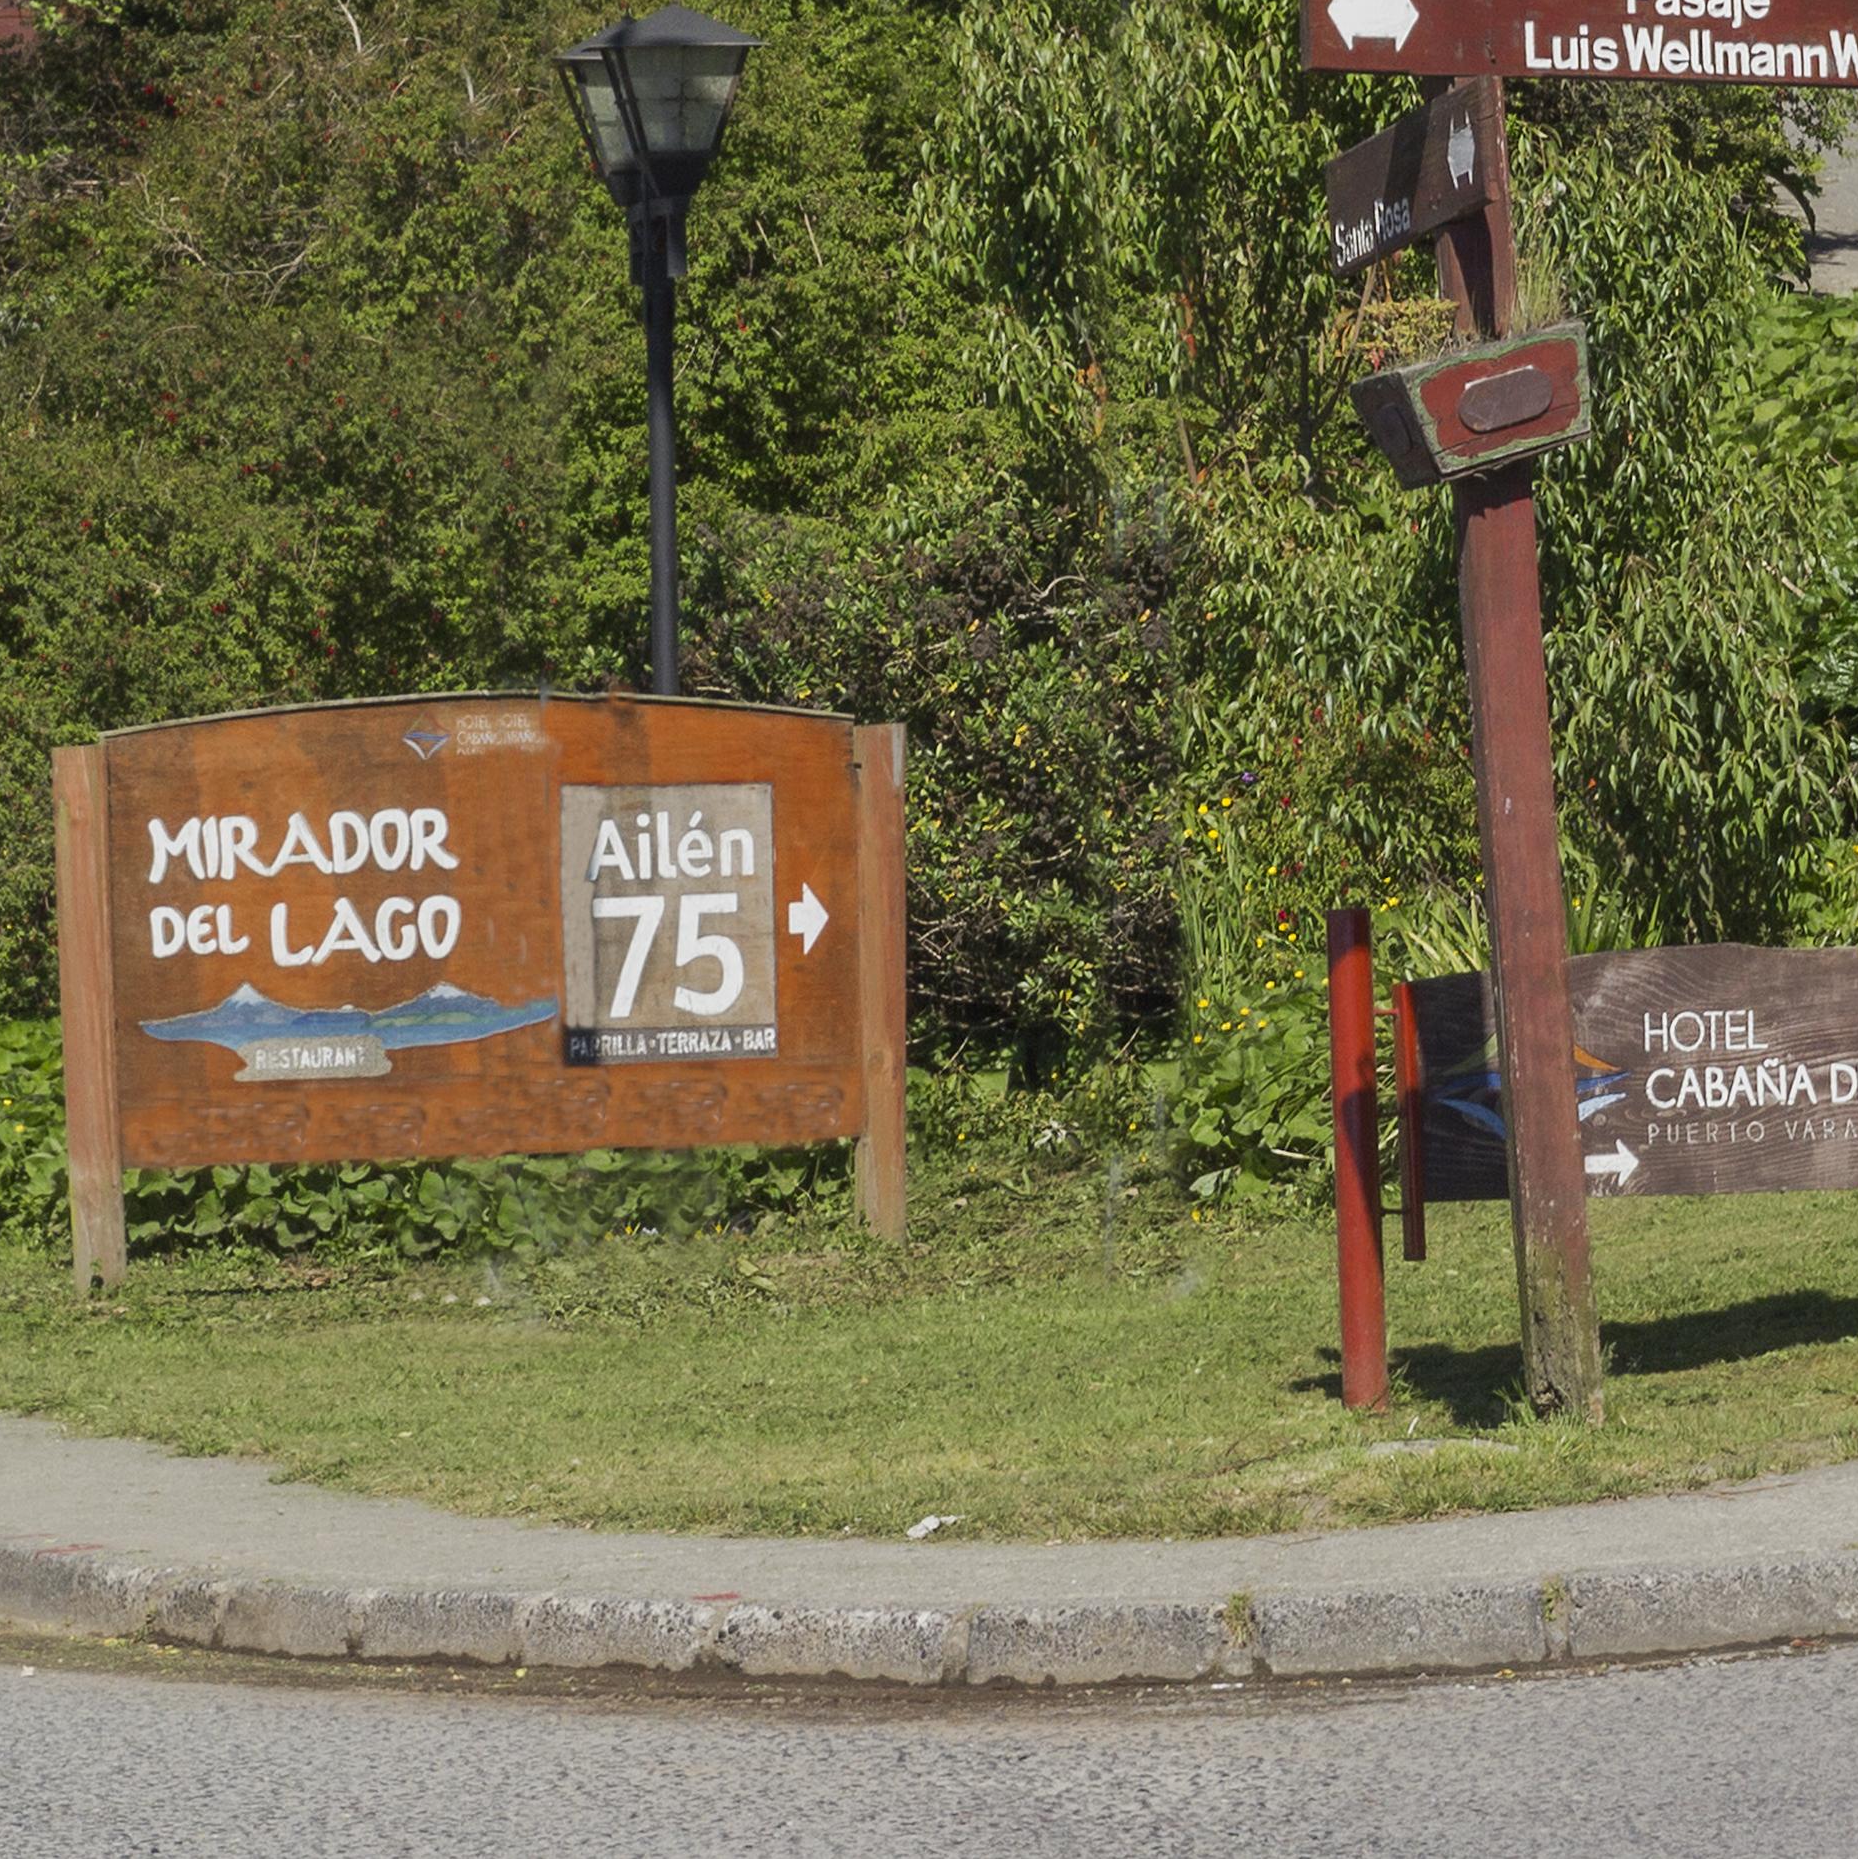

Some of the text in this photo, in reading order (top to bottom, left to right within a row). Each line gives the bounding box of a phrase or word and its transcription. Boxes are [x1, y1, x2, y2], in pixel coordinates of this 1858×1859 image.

[1525, 21, 1619, 70] Luis
[1622, 24, 1827, 78] Wellmann
[1335, 198, 1410, 267] Santa Rosa
[148, 808, 459, 884] MIRADOR
[588, 810, 755, 881] Ailén
[150, 895, 461, 967] DEL LAGO
[593, 893, 744, 1018] 75
[656, 1031, 732, 1054] TERRAZA
[743, 1028, 776, 1050] BAR
[1644, 1010, 1768, 1052] HOTEL
[1646, 1058, 1817, 1108] CABAÑA
[1647, 1121, 1765, 1144] PUERTO
